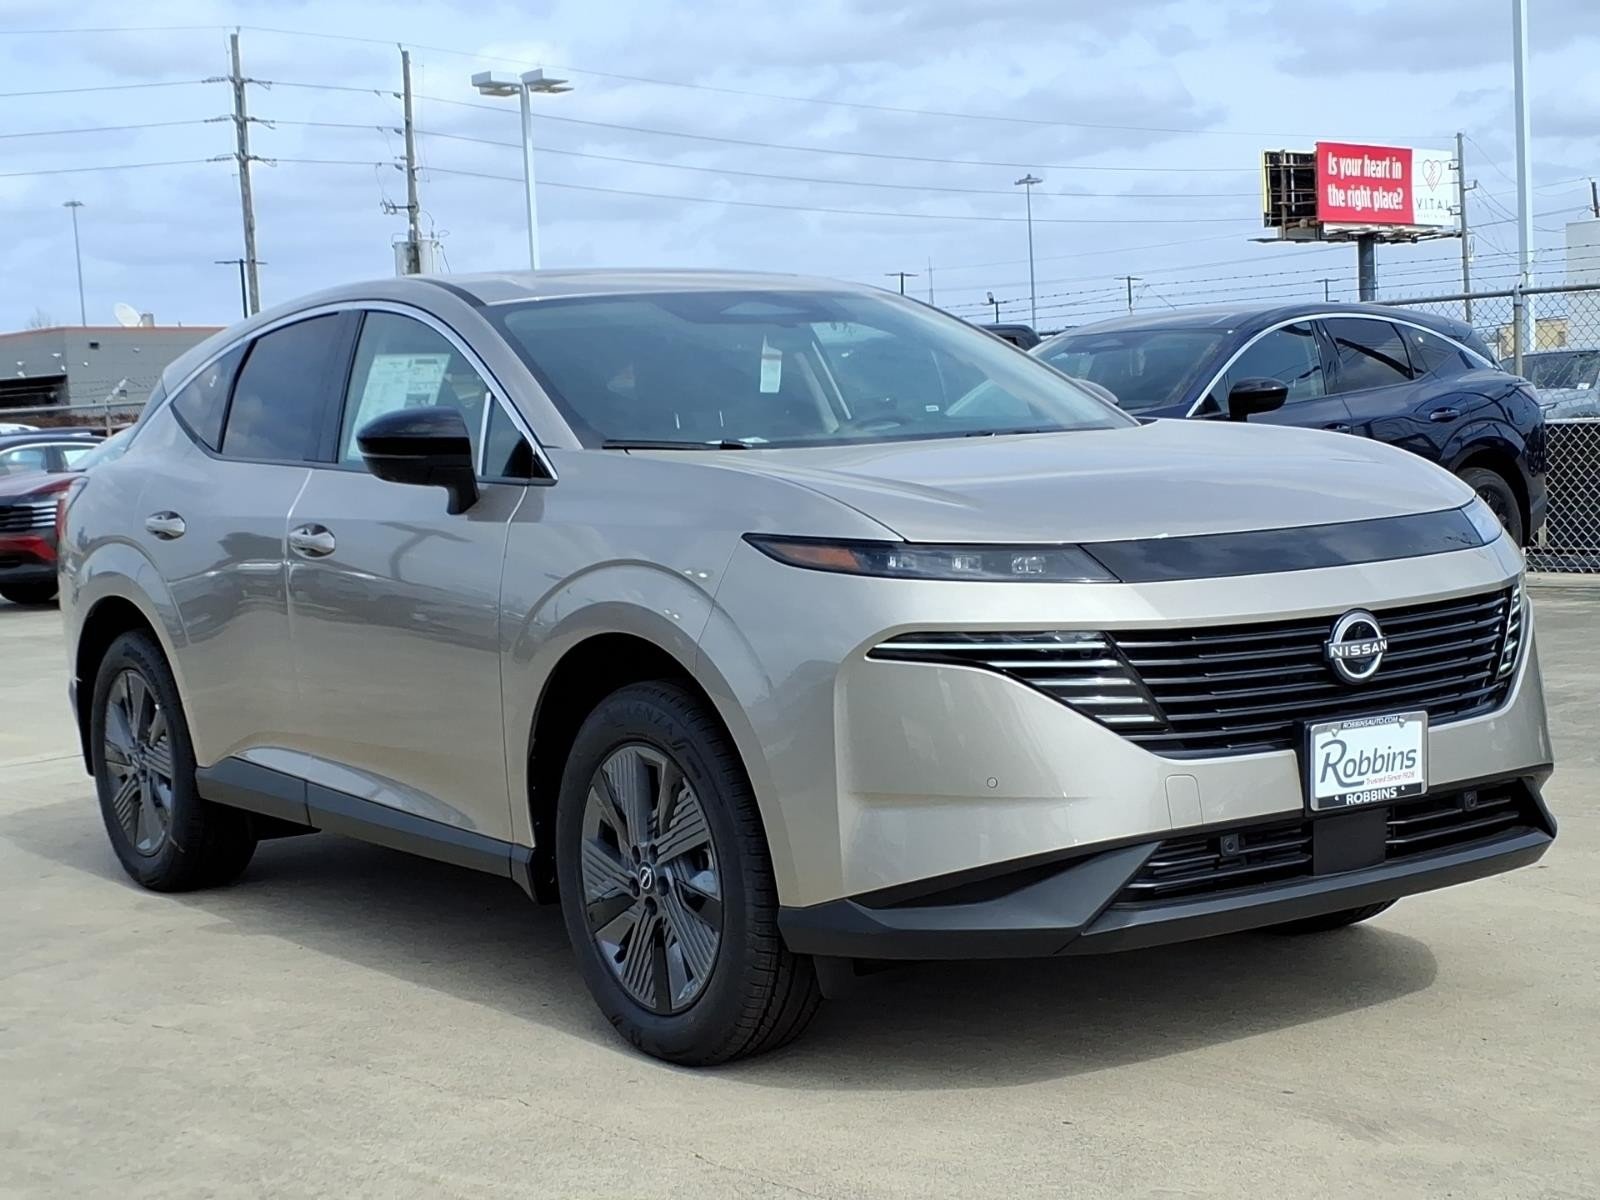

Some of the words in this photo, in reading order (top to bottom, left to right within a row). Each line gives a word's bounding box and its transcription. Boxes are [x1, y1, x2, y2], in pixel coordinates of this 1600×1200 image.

[1328, 152, 1338, 175] Is
[1339, 157, 1363, 180] your
[1364, 154, 1390, 179] heart
[1392, 156, 1402, 180] in
[1328, 183, 1346, 208] the
[1347, 184, 1372, 211] right
[1373, 186, 1403, 212] place?
[1330, 640, 1387, 658] NISSAN
[1319, 738, 1417, 788] Robbins
[1346, 787, 1397, 805] ROBBINS
